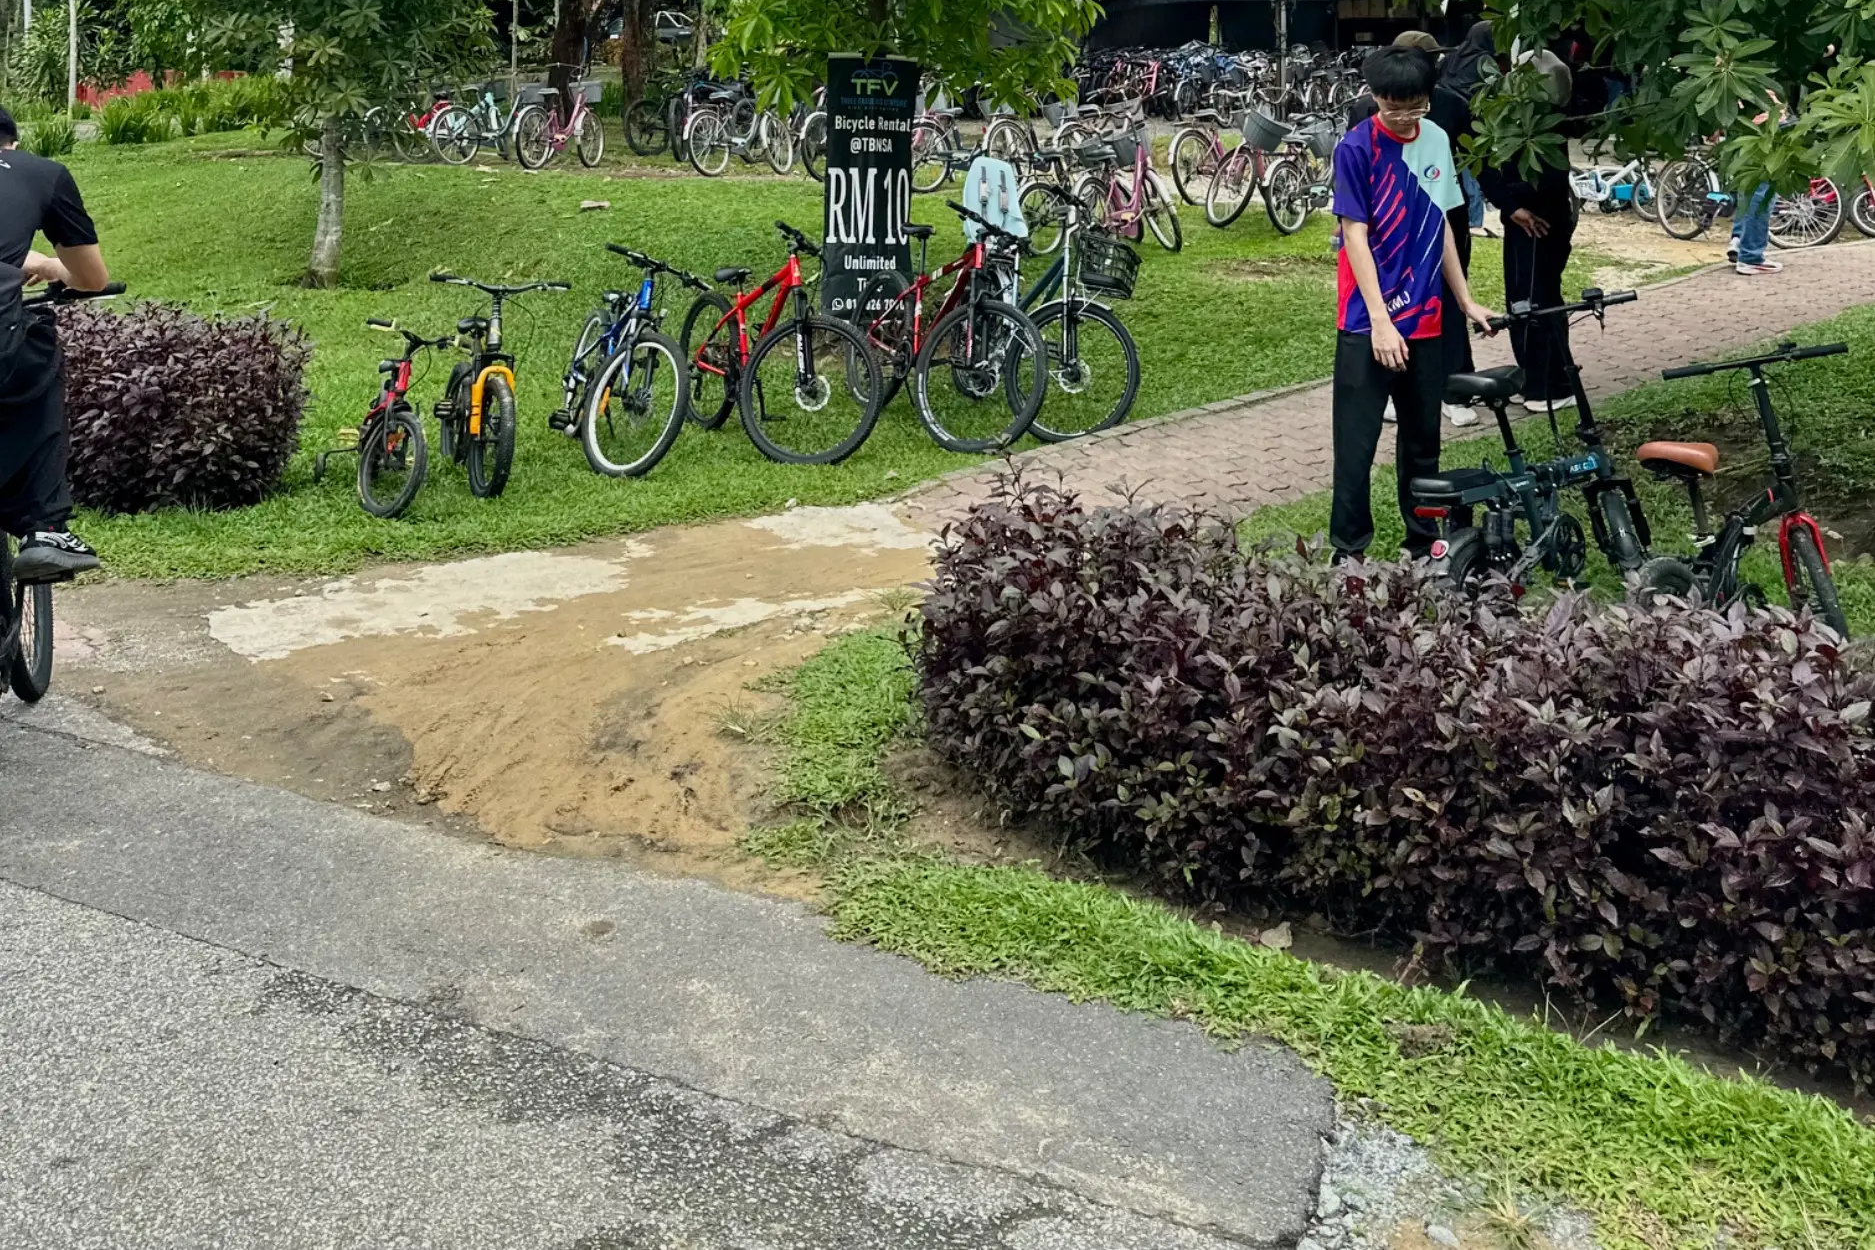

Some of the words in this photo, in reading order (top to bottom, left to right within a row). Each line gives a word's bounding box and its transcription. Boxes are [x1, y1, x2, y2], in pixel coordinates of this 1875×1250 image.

[851, 78, 899, 96] TFV
[835, 115, 875, 133] Bicycle
[878, 116, 911, 132] Rental
[850, 137, 893, 154] @TBNSA
[825, 167, 878, 244] RM
[883, 168, 910, 246] 10
[844, 255, 897, 270] Unlimited
